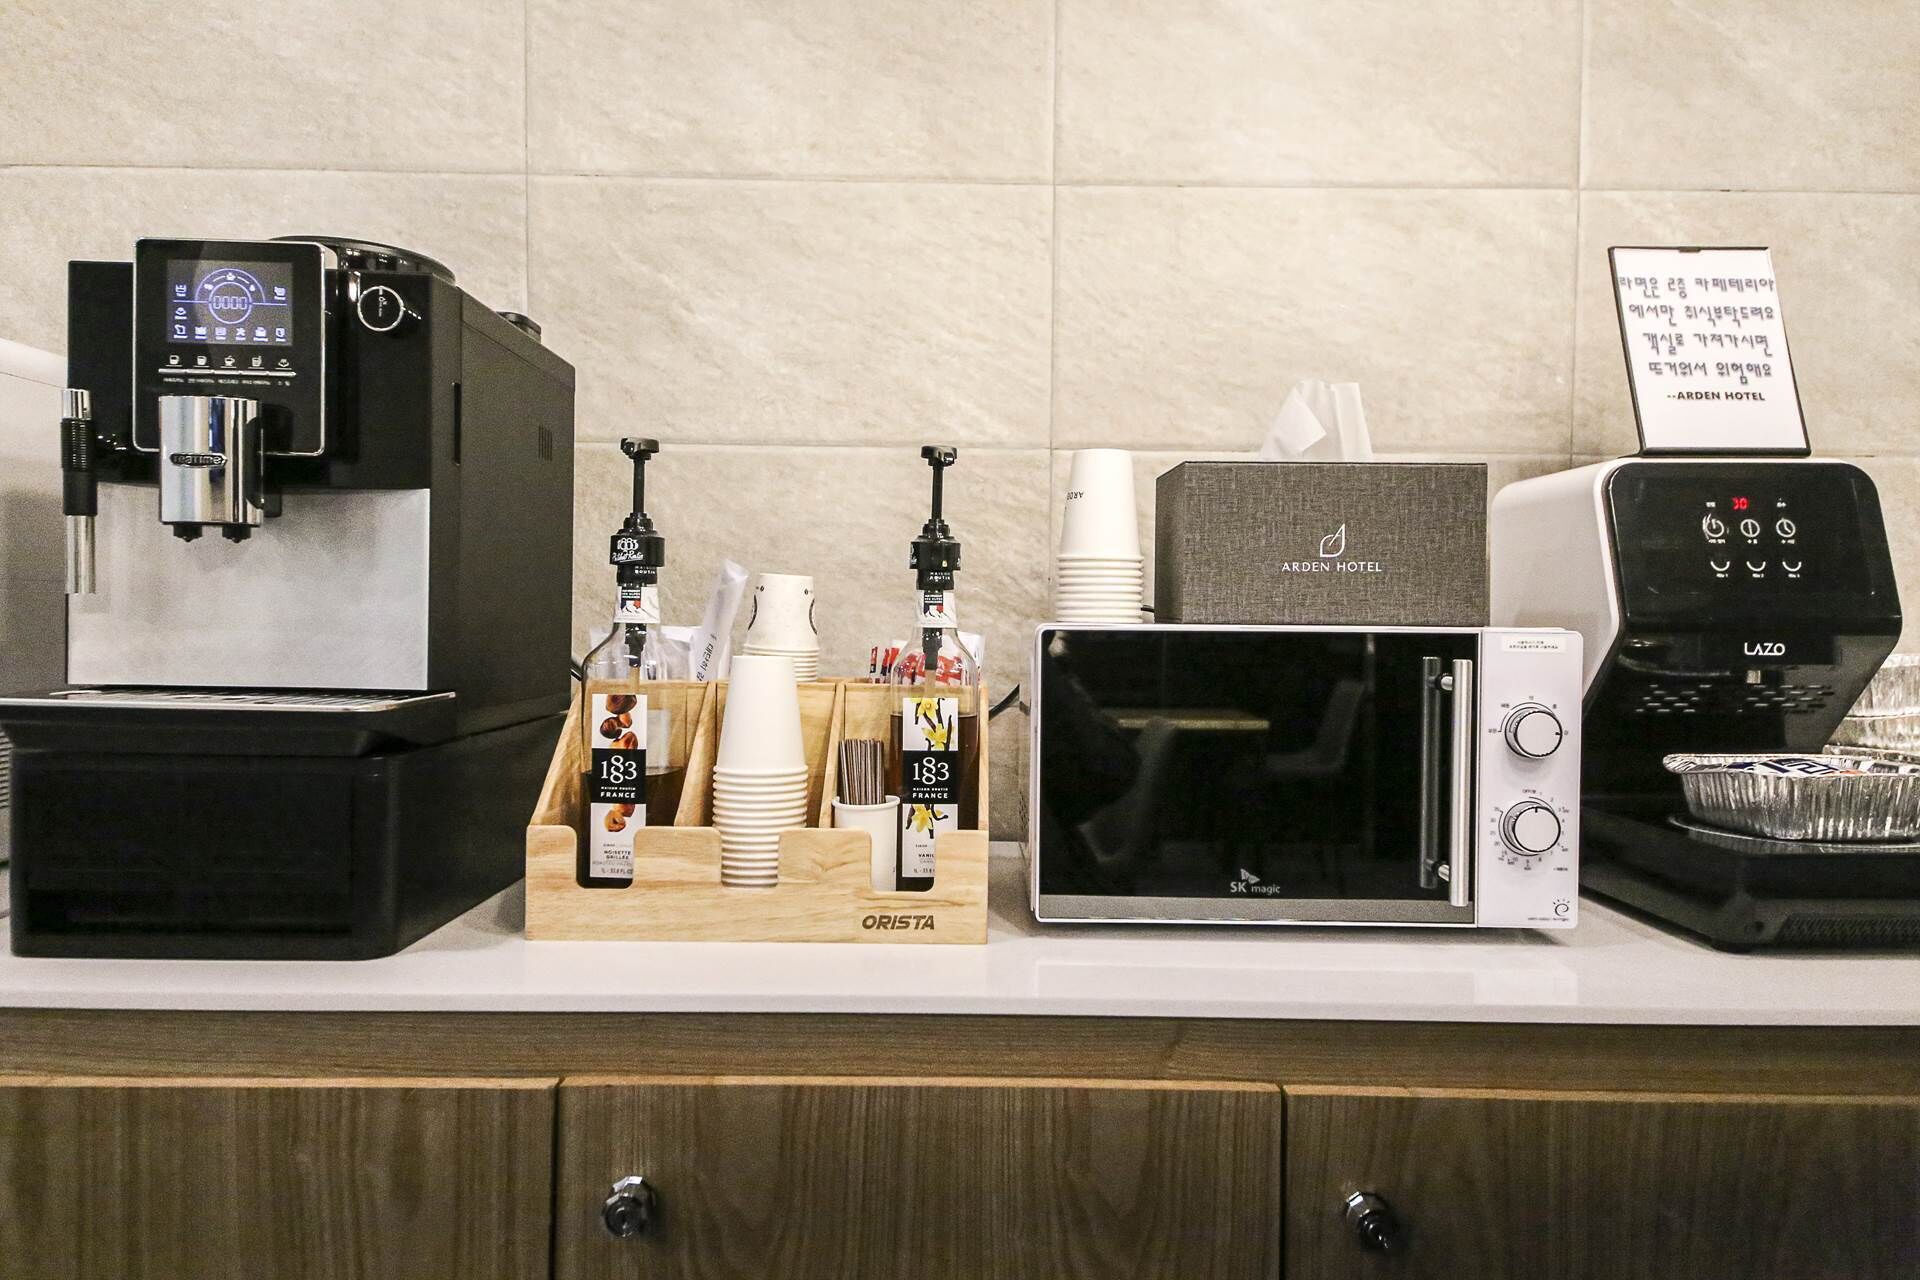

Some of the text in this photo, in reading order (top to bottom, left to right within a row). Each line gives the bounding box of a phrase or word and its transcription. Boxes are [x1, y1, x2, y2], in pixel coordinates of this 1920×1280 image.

[1619, 277, 1661, 299] 라면은
[1694, 277, 1775, 293] 카페테리아
[1628, 304, 1775, 328] 에서만 취식부탁드려요
[1642, 333, 1774, 357] 객실로 가져가시면
[1648, 361, 1708, 377] 뜨거워서
[1724, 391, 1766, 401] HOTEL
[1281, 561, 1383, 572] ARDEN HOTEL
[1744, 642, 1786, 656] LAZO
[600, 791, 636, 799] FRANCE
[1230, 881, 1281, 896] SK magic
[862, 914, 935, 930] ORISTA
